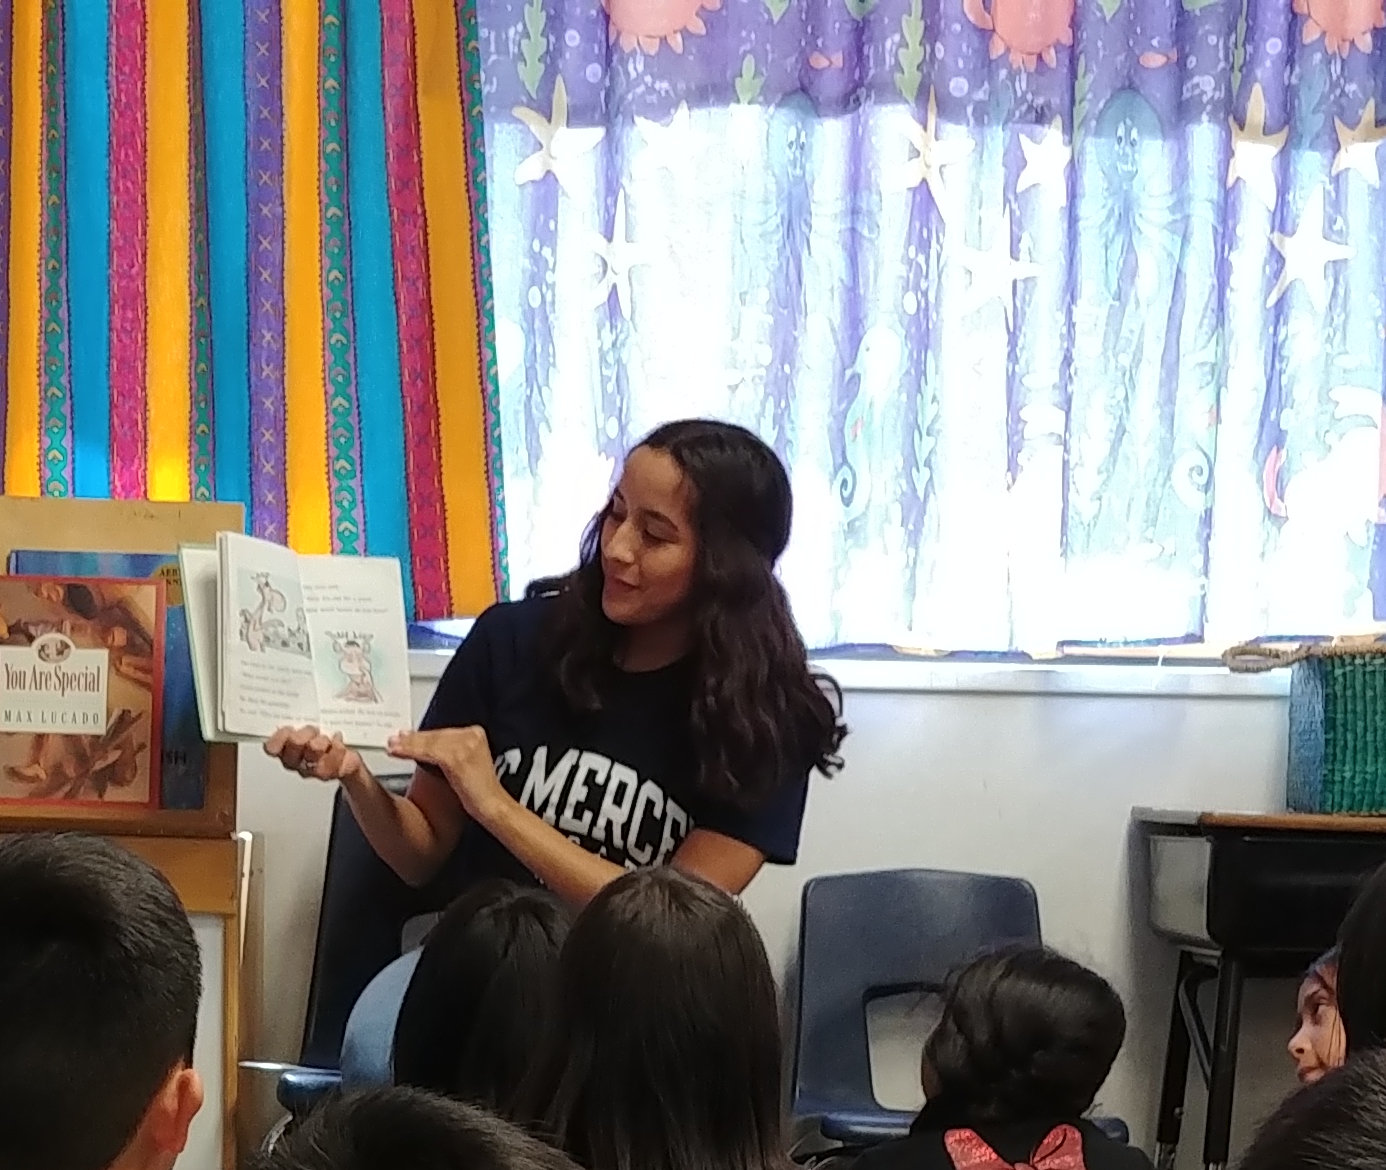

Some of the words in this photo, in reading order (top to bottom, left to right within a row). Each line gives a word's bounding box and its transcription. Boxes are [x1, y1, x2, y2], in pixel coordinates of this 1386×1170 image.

[4, 663, 26, 691] You
[29, 664, 52, 692] Are
[54, 665, 101, 698] Special
[4, 709, 32, 723] MAX
[41, 710, 99, 725] LUCADO
[519, 745, 696, 869] MERCE
